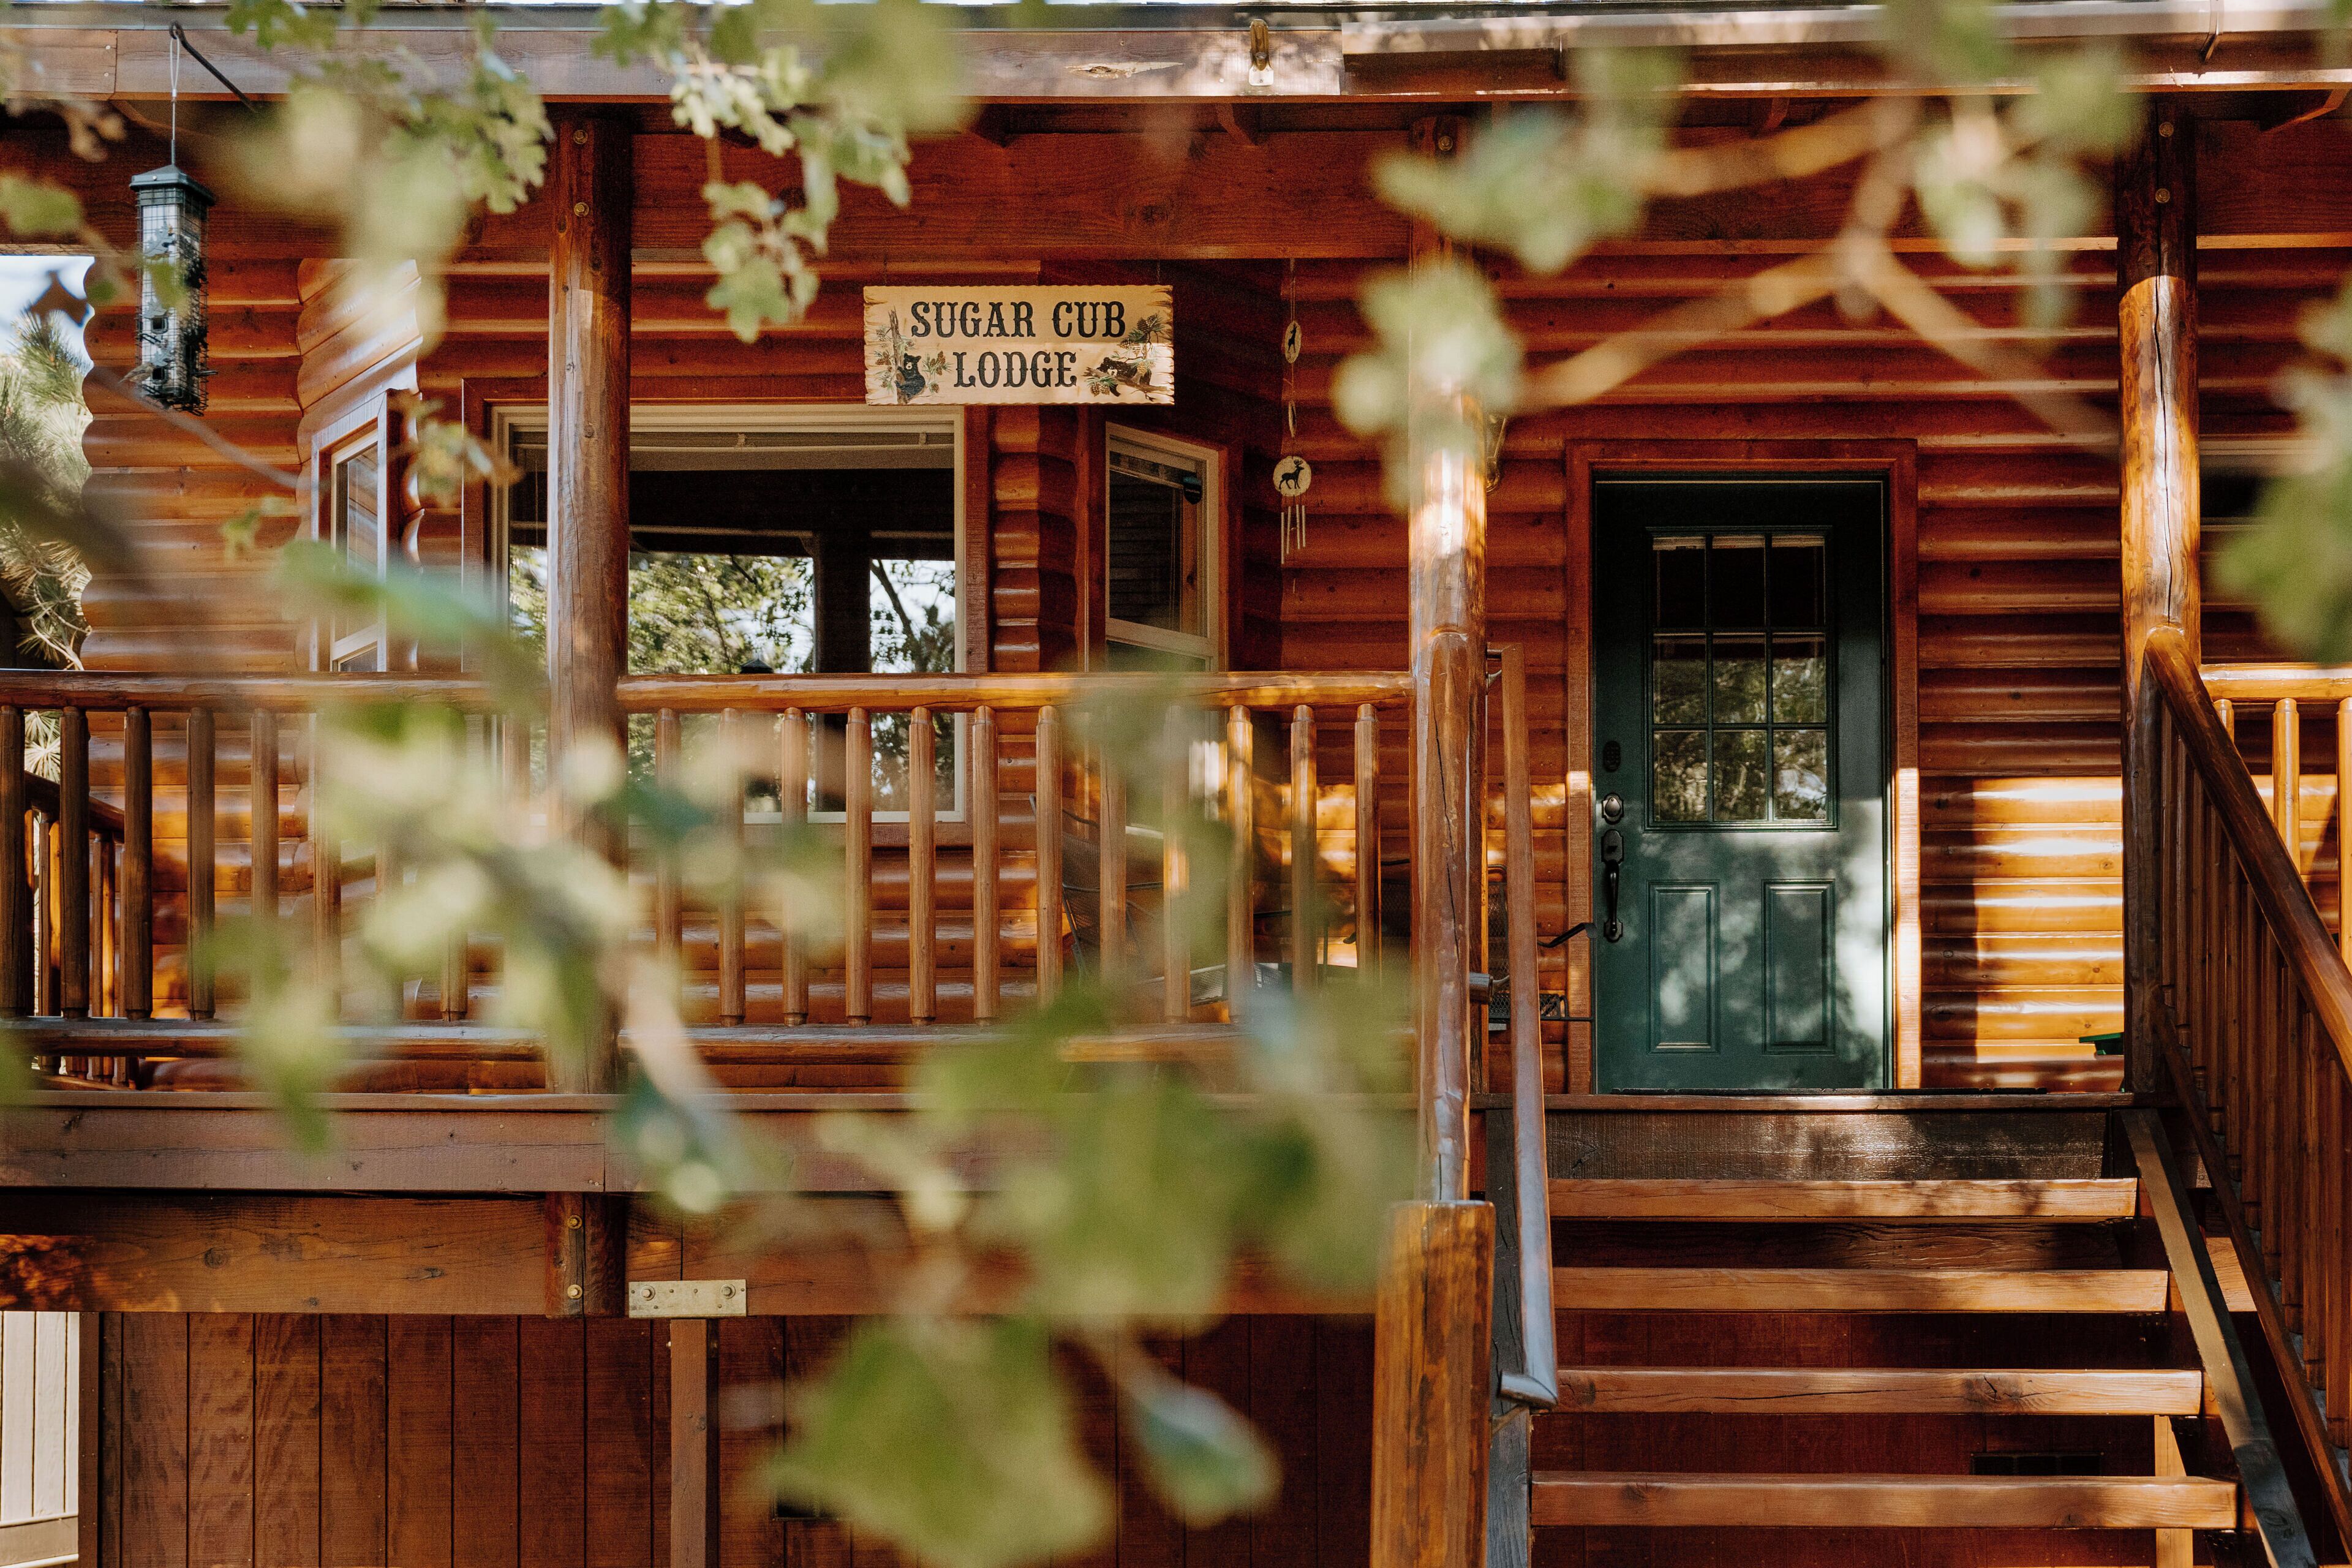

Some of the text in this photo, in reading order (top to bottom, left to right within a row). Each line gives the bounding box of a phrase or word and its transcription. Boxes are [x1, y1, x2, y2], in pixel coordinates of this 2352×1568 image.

[911, 301, 1126, 338] SUGAR CUB
[953, 351, 1077, 388] LODGE
